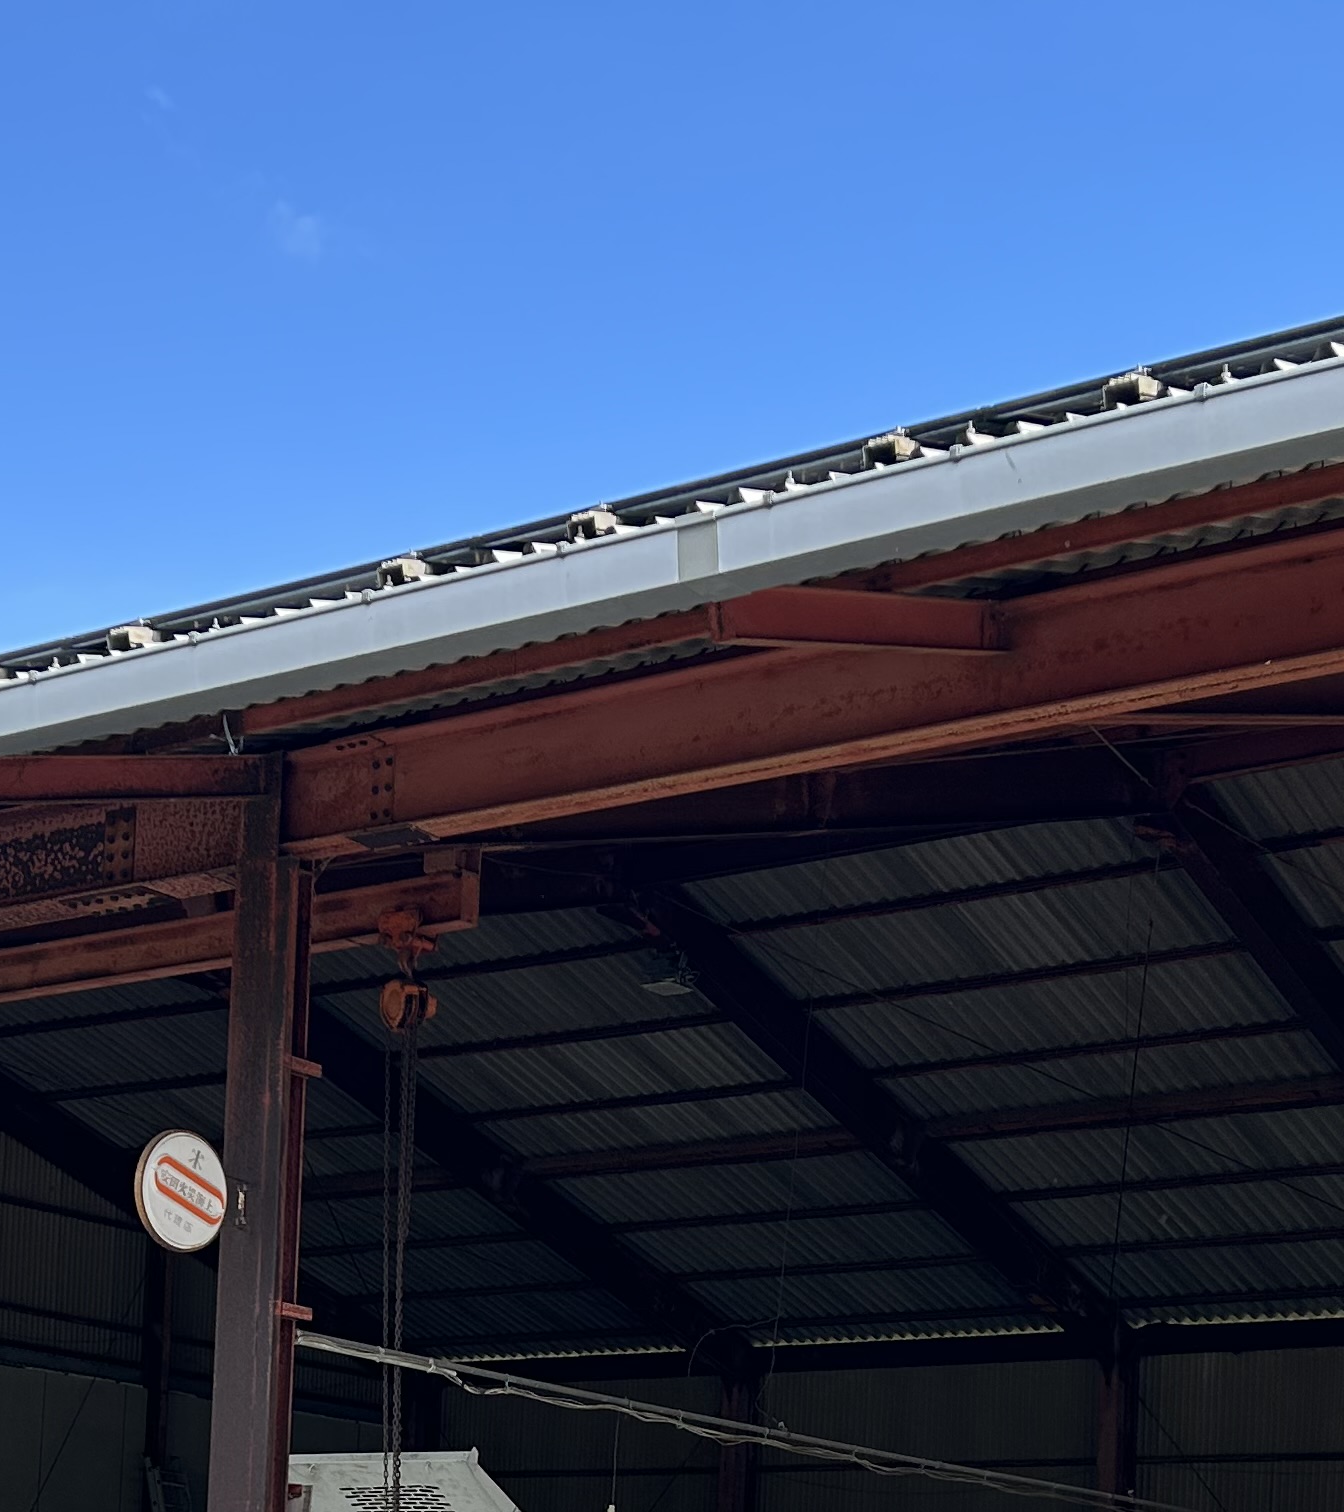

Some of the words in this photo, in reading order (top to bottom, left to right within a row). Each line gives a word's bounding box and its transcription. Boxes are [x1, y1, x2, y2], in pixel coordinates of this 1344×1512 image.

[160, 1168, 214, 1213] 安田火災海上
